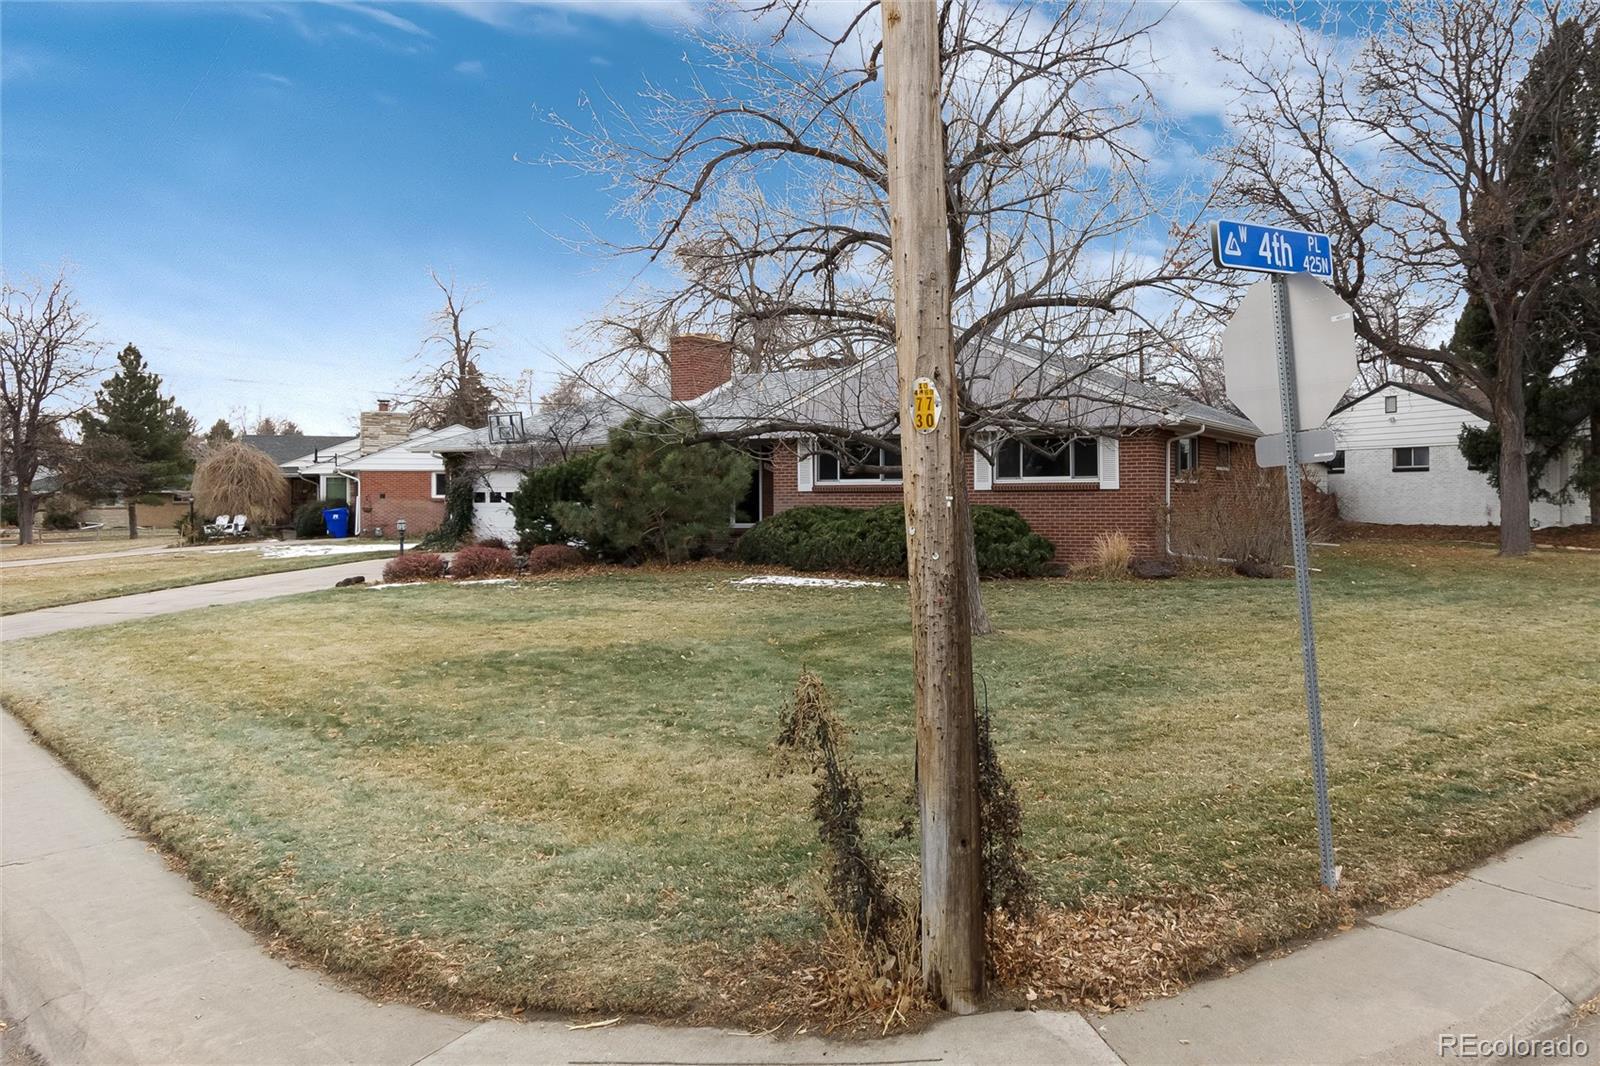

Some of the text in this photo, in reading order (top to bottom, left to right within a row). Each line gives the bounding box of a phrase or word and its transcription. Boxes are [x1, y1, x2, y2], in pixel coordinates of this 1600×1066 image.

[1238, 225, 1321, 267] W 4th PL
[1303, 256, 1329, 274] 425N
[916, 413, 934, 428] 30
